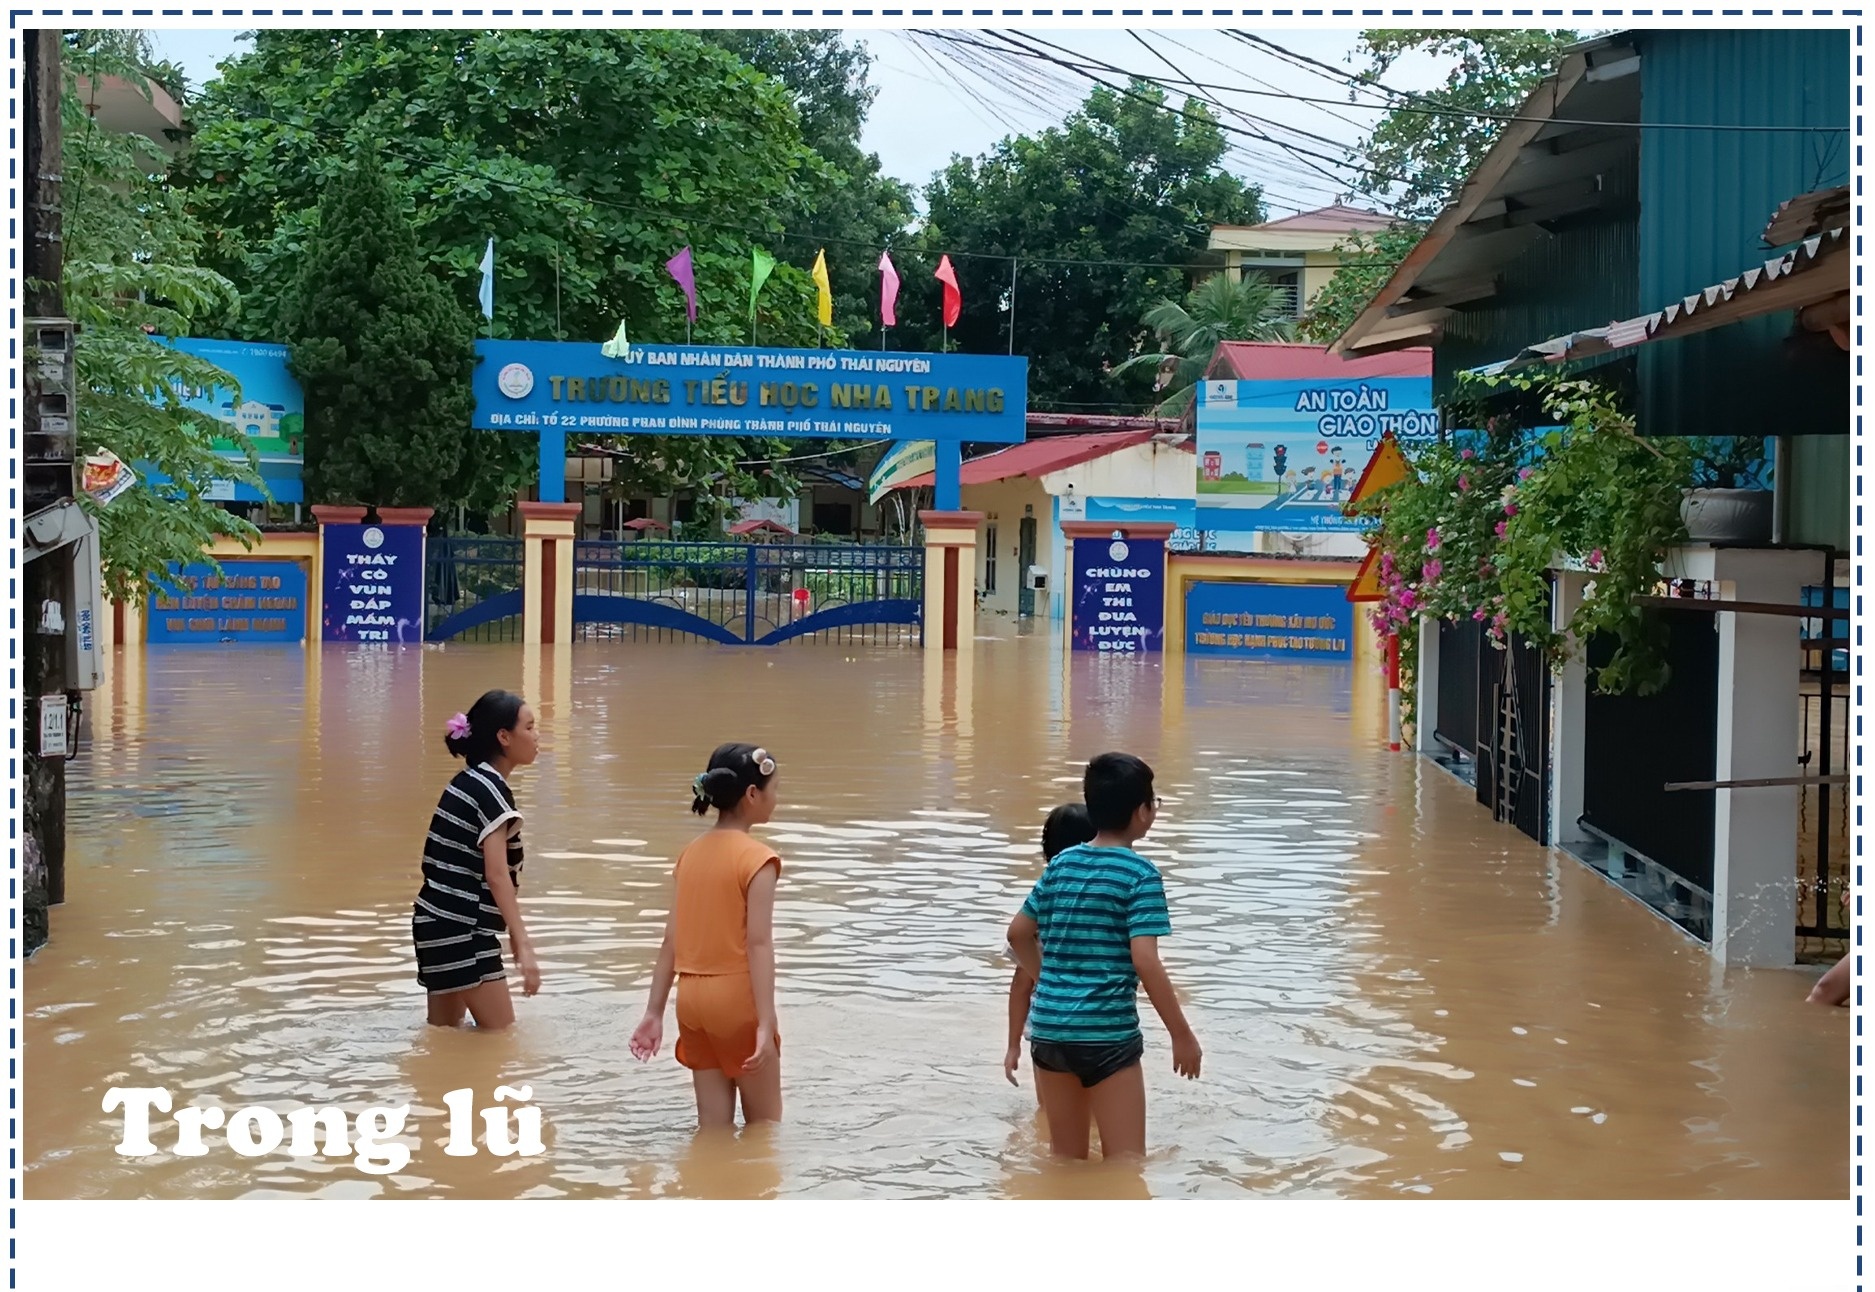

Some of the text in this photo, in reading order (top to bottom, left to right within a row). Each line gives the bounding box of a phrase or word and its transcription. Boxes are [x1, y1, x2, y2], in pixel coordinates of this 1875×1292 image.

[648, 352, 677, 367] BAN
[680, 352, 722, 368] NHÂN
[724, 353, 752, 369] DÂN
[757, 354, 805, 370] THÀNH
[808, 353, 836, 371] PHỐ
[840, 356, 873, 372] THÁI
[876, 358, 930, 373] NGUYÊN
[549, 372, 670, 404] TRƯỜNG
[759, 382, 818, 413] HỌC
[831, 383, 892, 411] NHA
[905, 385, 1004, 413] TRANG
[1296, 384, 1388, 411] AN TOÀN
[561, 416, 576, 427] 22
[632, 416, 665, 429] PHAN
[814, 420, 840, 433] THÁI
[845, 421, 891, 434] NGUYÊN
[1318, 409, 1452, 437] GIAO THÔN
[361, 568, 388, 580] CÔ
[349, 585, 392, 595] VUN
[1105, 583, 1132, 593] EM
[1102, 597, 1132, 607] THI
